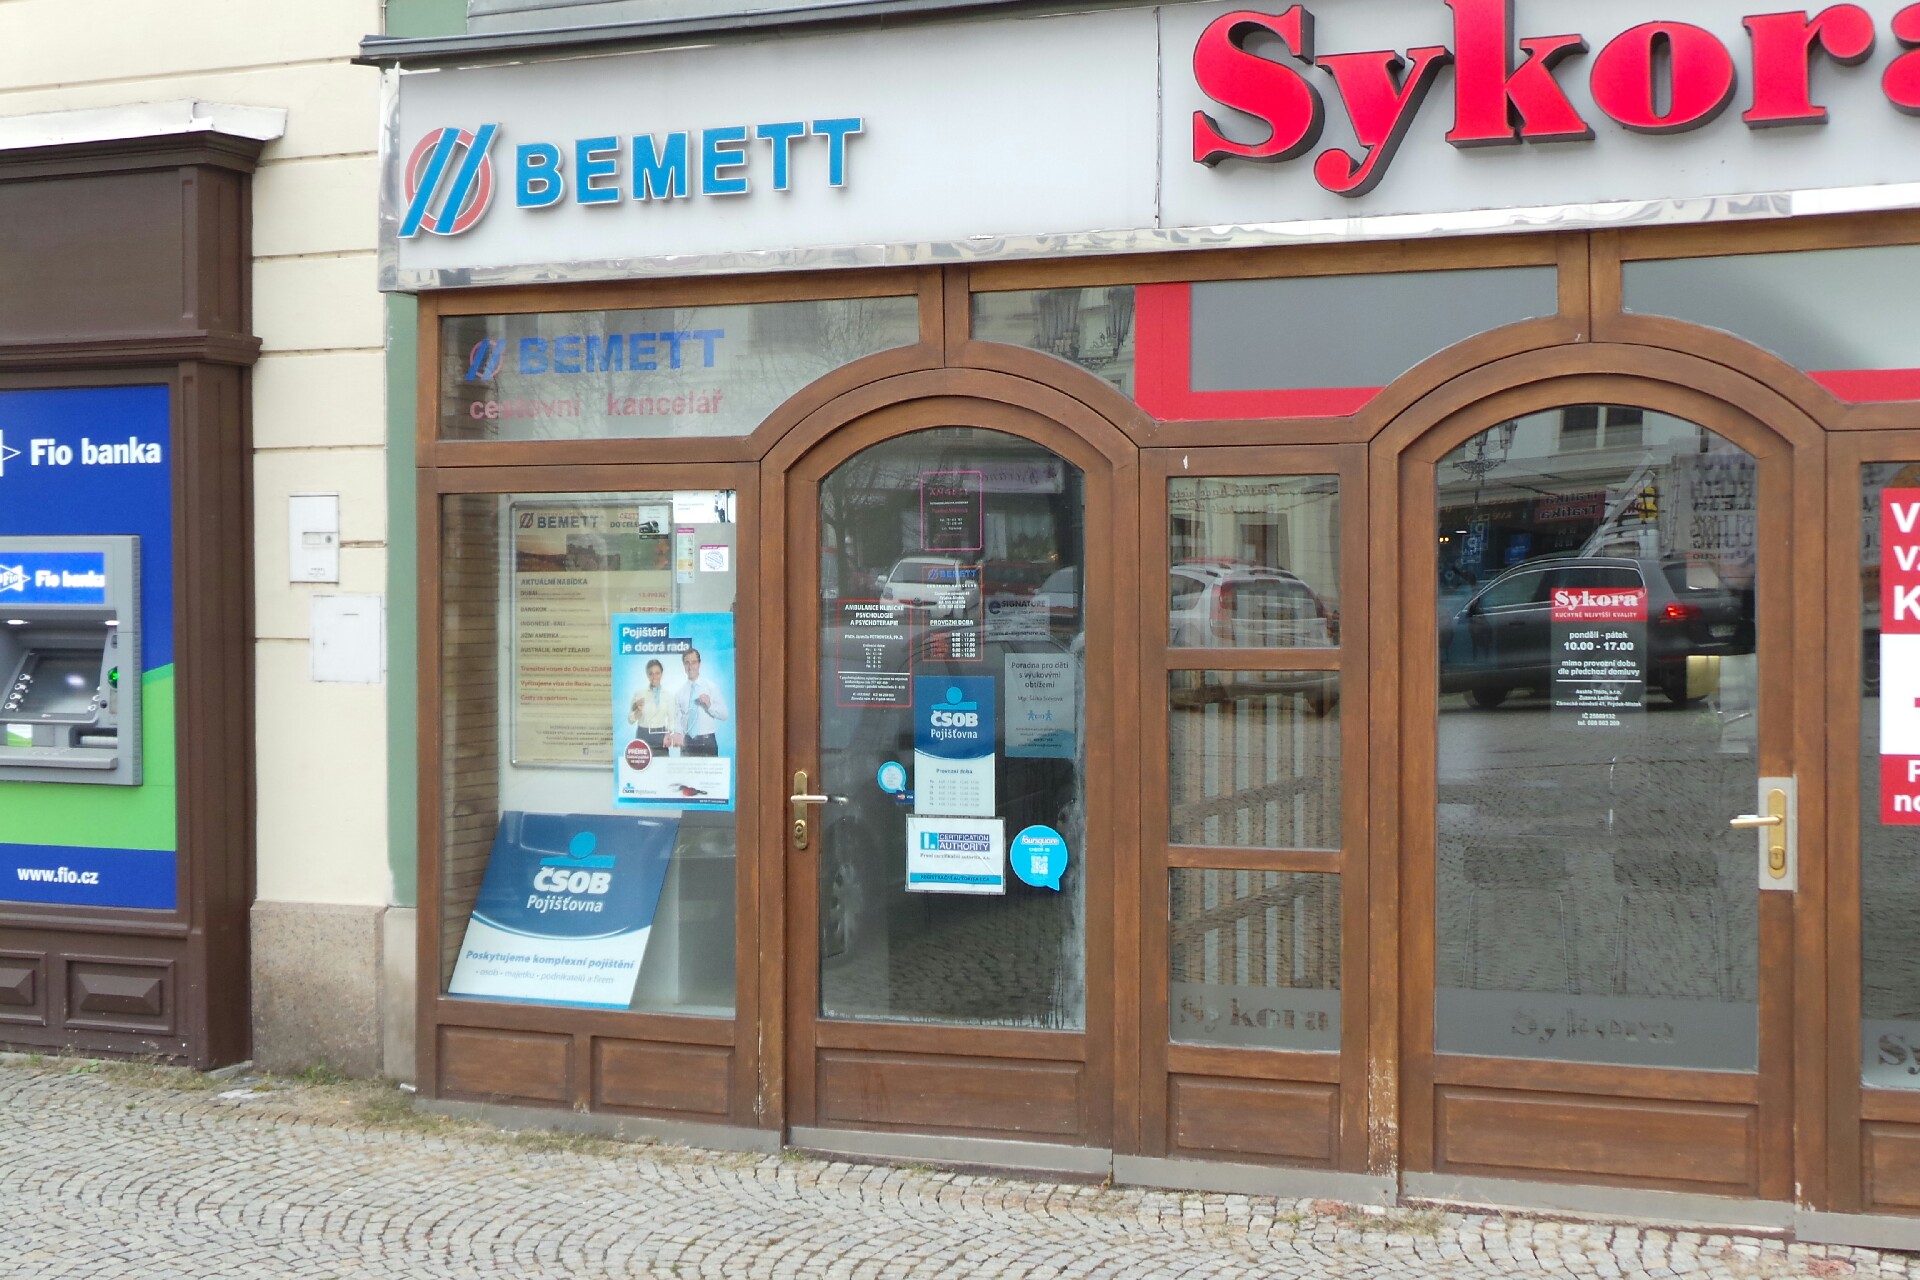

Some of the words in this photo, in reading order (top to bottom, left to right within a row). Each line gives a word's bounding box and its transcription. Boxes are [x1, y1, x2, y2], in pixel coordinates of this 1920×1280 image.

[515, 116, 866, 209] BEMETT
[519, 329, 725, 374] BEMETT
[470, 391, 581, 419] cestovní
[608, 389, 723, 416] kancelář
[30, 438, 73, 466] Fio
[81, 437, 162, 465] banka
[537, 516, 598, 528] BEMETT
[35, 570, 60, 587] Fio
[1555, 591, 1638, 610] Sykora
[622, 626, 666, 639] Pojištění
[1606, 631, 1628, 639] pátek
[622, 643, 632, 654] je
[634, 642, 664, 652] dobrá
[667, 642, 690, 651] rada
[1564, 642, 1593, 650] 10.00
[1604, 642, 1634, 650] 17.00
[930, 711, 978, 727] ČSOB
[930, 729, 978, 740] Pojišťovna
[17, 867, 99, 884] www.fio.cz
[534, 867, 611, 894] ČSOB
[527, 895, 603, 913] Pojišťovna
[466, 951, 531, 964] Poskytujeme
[533, 954, 586, 969] komplexní
[588, 958, 635, 969] pojištění
